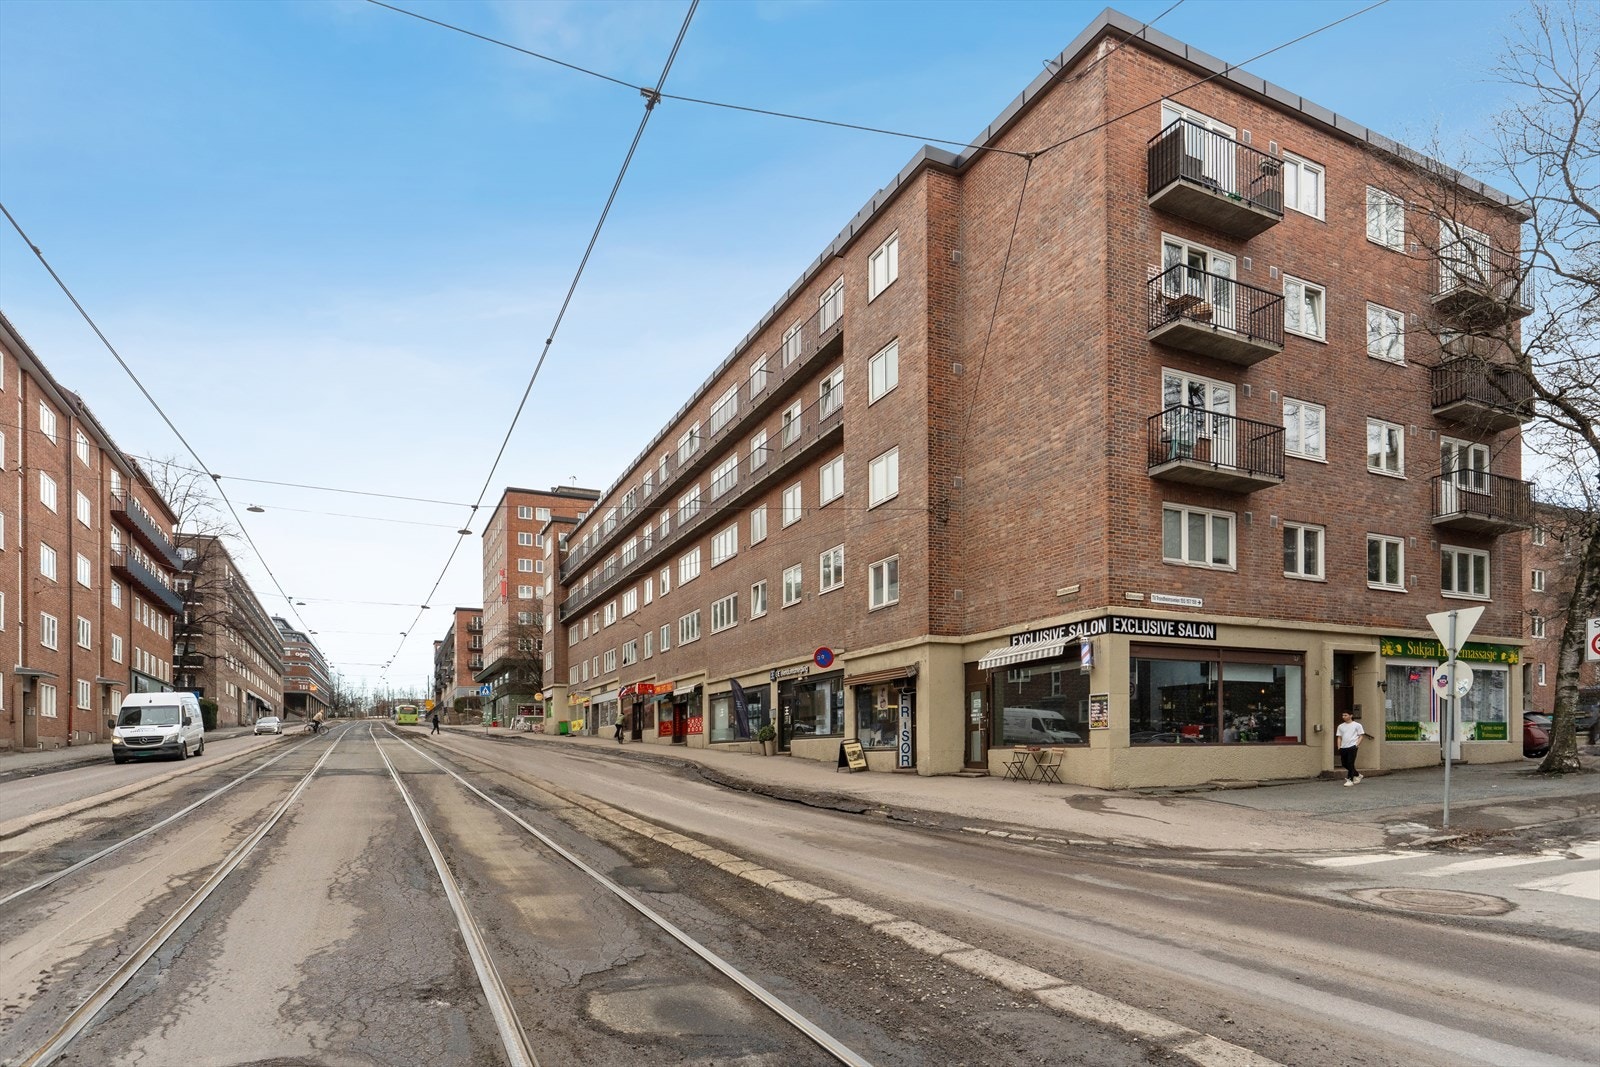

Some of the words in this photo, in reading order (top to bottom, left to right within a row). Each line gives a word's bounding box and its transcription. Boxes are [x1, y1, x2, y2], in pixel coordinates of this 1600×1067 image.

[1012, 626, 1066, 646] EXCLUSIVE
[1068, 618, 1107, 637] SALON
[1112, 617, 1175, 636] EXCLUSIVE
[1178, 622, 1214, 639] SALON
[1407, 640, 1435, 659] Sukjai
[1437, 642, 1497, 663] Hemassasje
[901, 694, 911, 766] FRISØR
